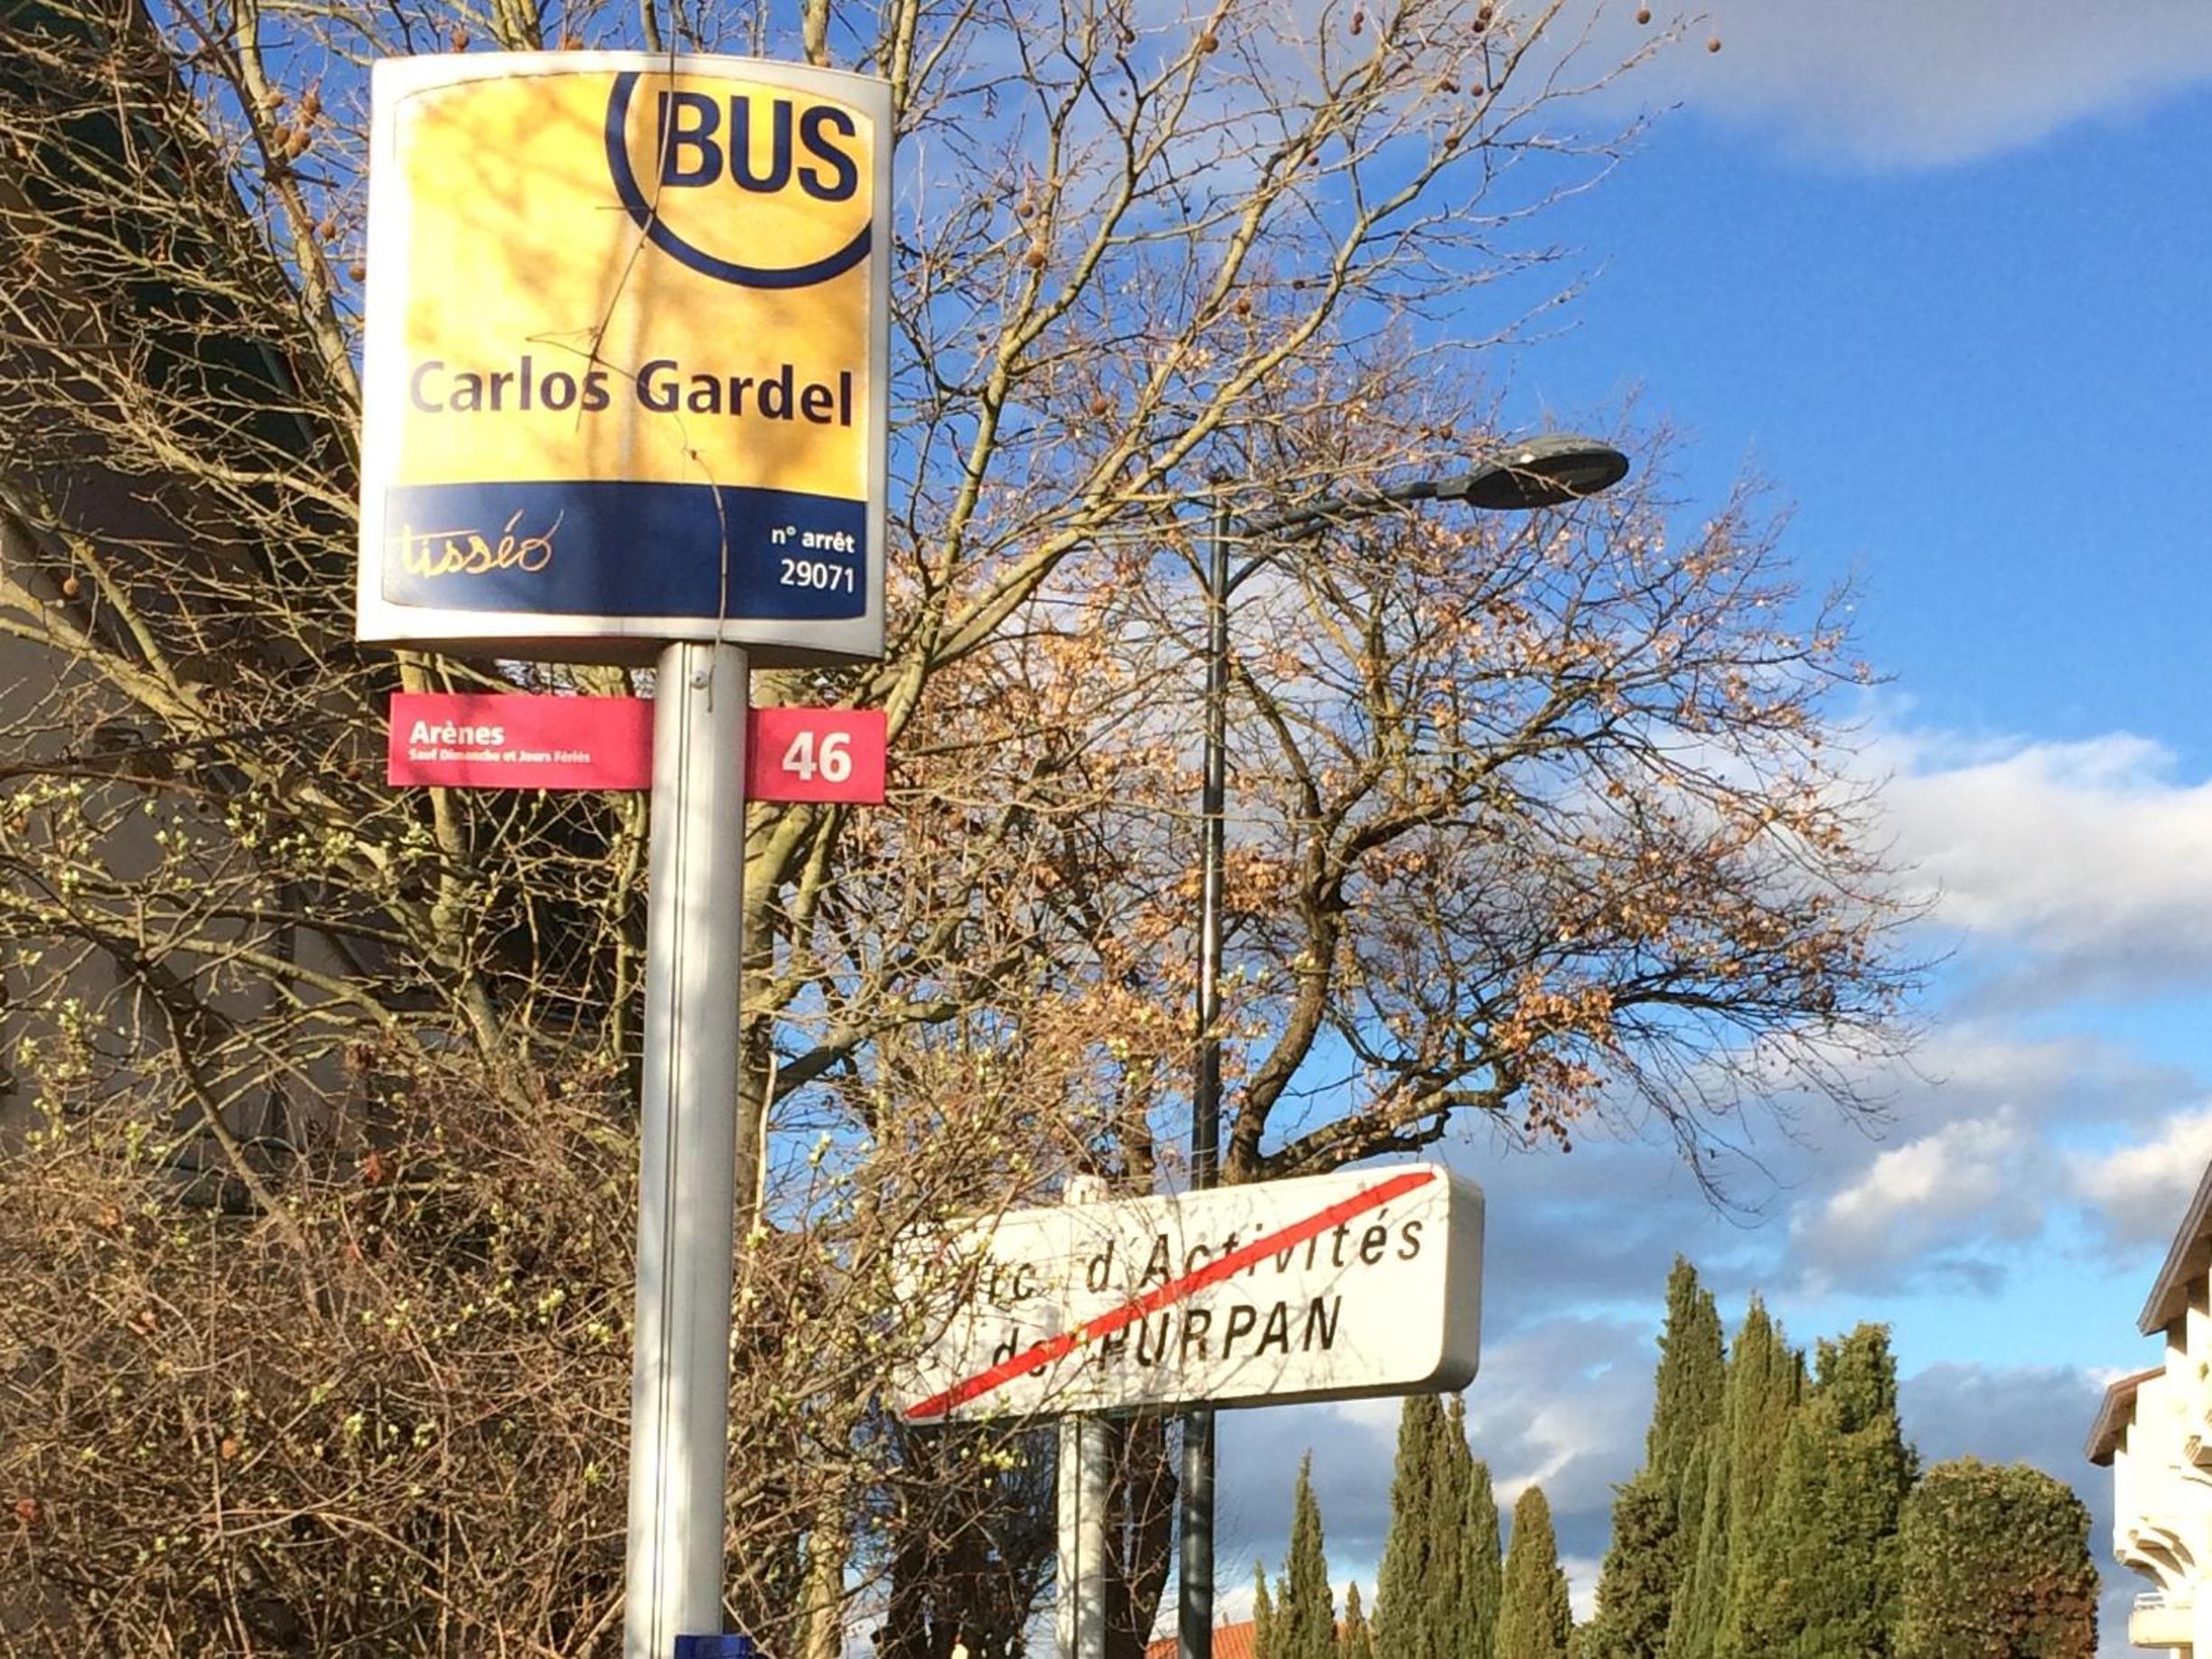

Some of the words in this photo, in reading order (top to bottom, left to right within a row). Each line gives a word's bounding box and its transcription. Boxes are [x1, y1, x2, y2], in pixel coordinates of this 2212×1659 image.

[657, 90, 858, 202] BUS
[409, 355, 611, 414] Carlos
[636, 360, 853, 426] Gardel
[801, 531, 855, 554] arrêt
[780, 558, 854, 593] 29071
[409, 721, 505, 745] Arènes
[409, 748, 437, 761] Sauf
[782, 732, 852, 783] 46
[1097, 1295, 1342, 1372] PURPAN
